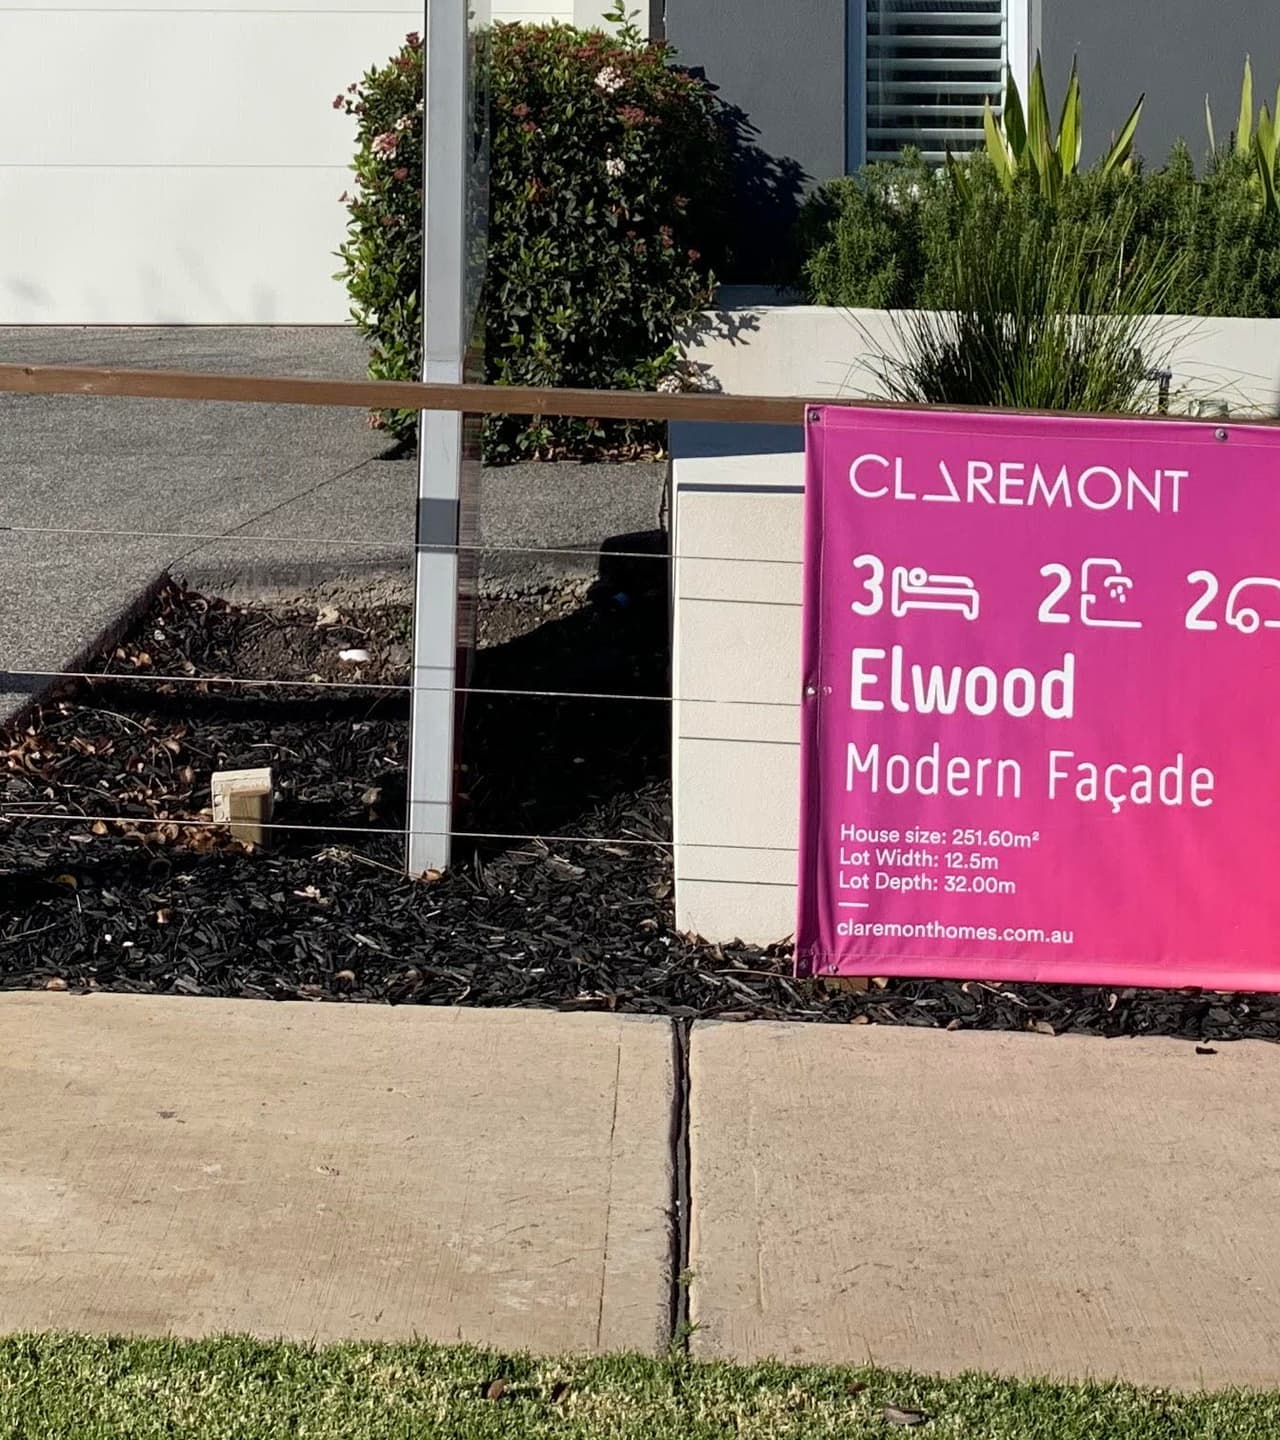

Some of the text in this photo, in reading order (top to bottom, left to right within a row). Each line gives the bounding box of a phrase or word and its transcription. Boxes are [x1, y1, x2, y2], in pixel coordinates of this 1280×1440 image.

[850, 553, 886, 617] 3
[1037, 562, 1073, 625] 2
[850, 645, 1075, 720] Elwood
[845, 741, 1216, 815] Modern Façade
[839, 822, 1041, 849] House size: 251.60m²
[838, 846, 1000, 871] Lot Width: 12.5m
[838, 870, 1017, 895] Lot Depth: 32.00m
[836, 918, 1074, 944] claremonthomes.com.au
